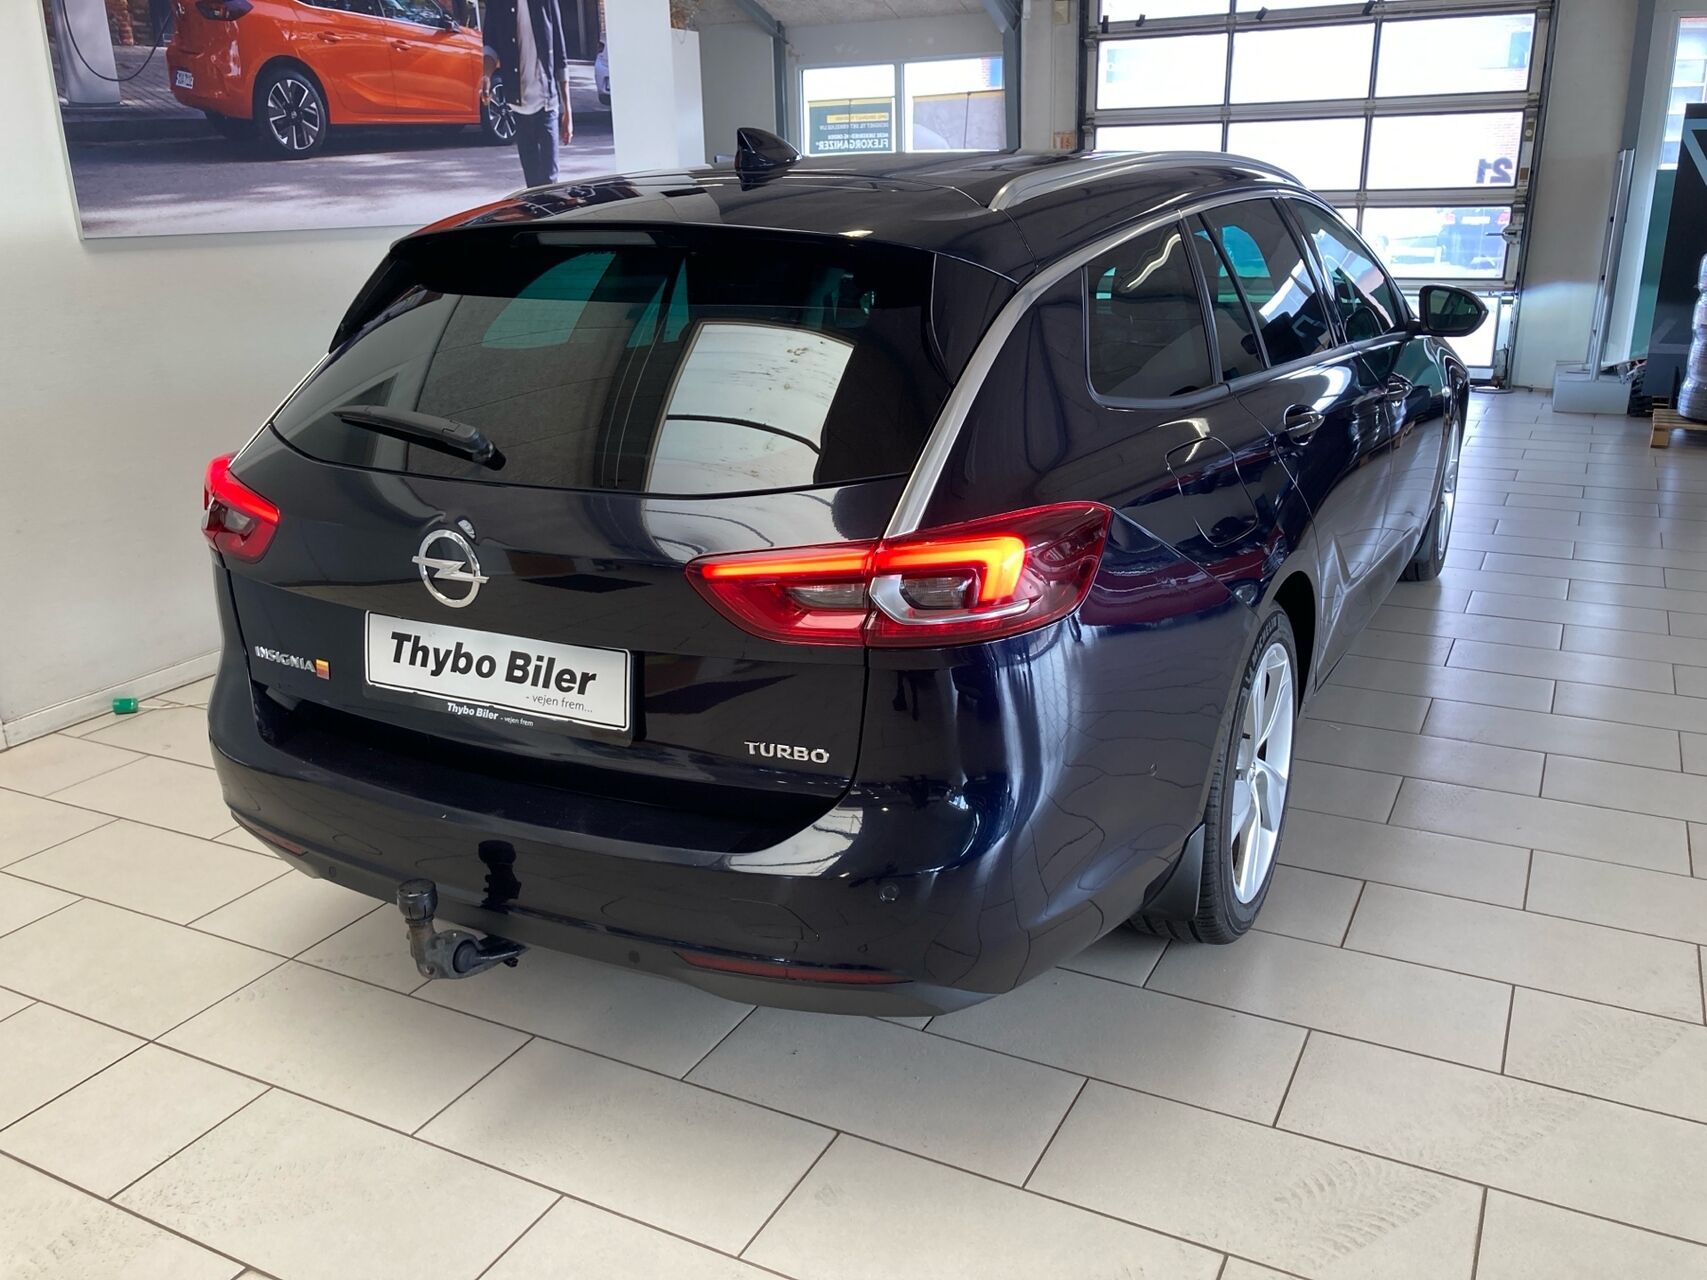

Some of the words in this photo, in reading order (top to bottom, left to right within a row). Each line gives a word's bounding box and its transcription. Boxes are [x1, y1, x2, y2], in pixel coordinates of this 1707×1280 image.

[254, 645, 317, 673] INSIGNIA
[391, 631, 497, 678] Thybo
[505, 650, 597, 696] Biler
[532, 694, 559, 707] vejen
[447, 702, 475, 716] Thybo
[476, 707, 499, 720] Biler
[505, 715, 520, 726] vejen
[520, 717, 534, 727] frem
[743, 741, 830, 764] TURBO
